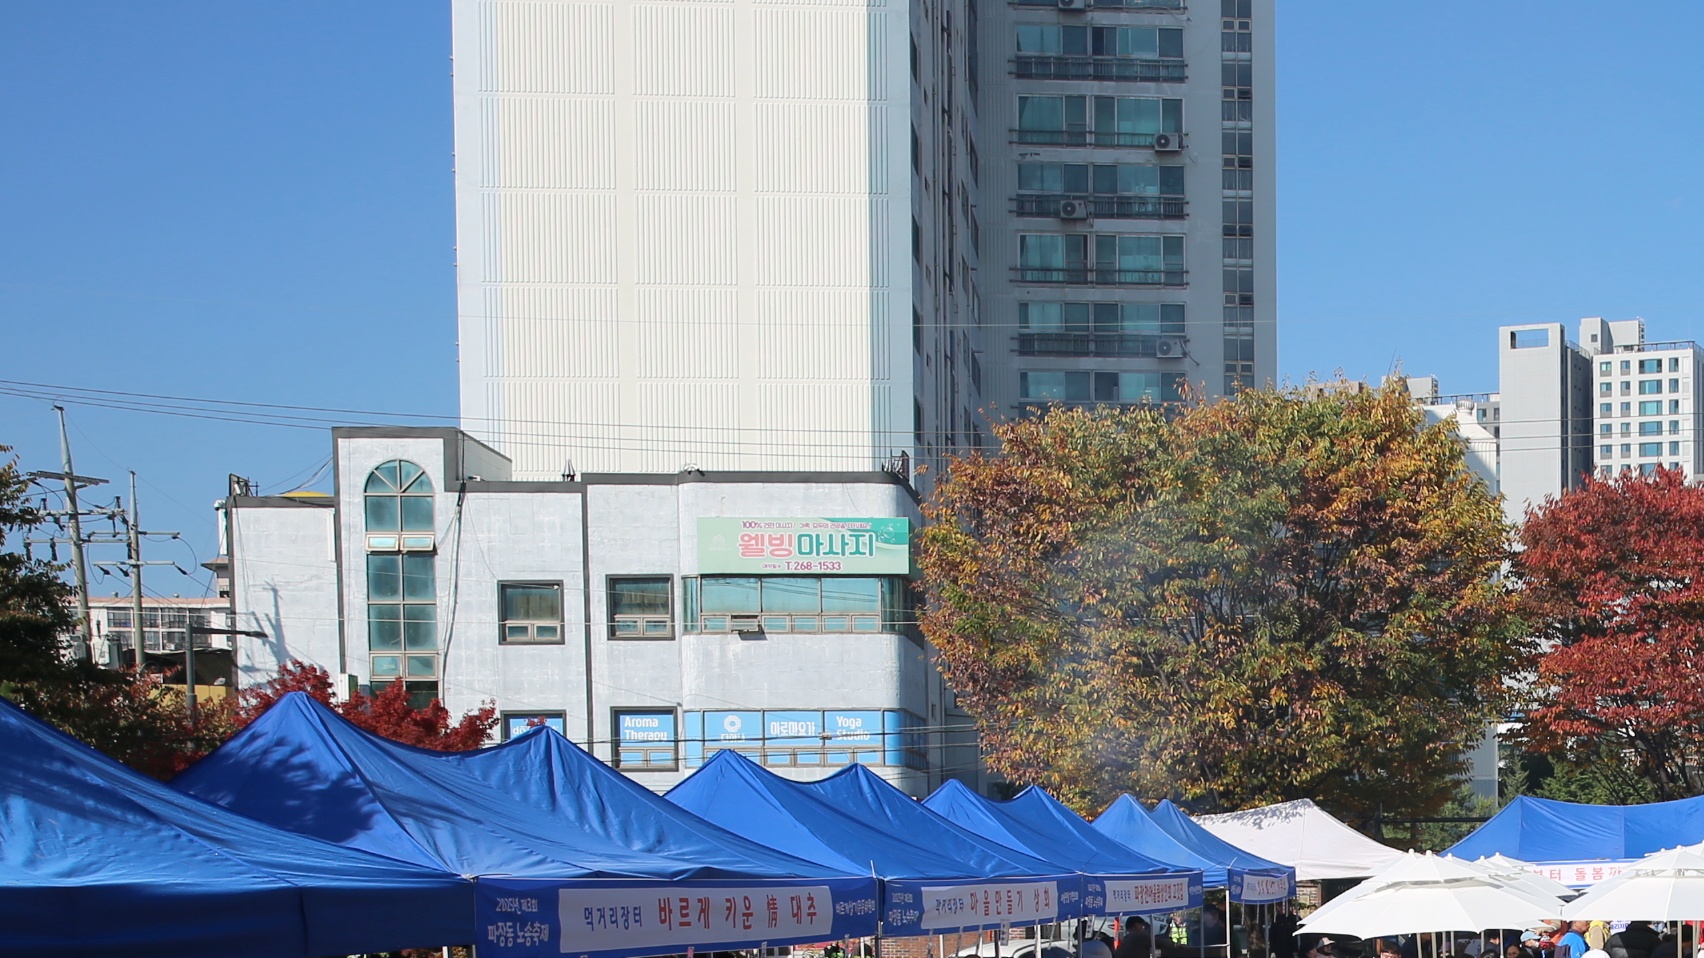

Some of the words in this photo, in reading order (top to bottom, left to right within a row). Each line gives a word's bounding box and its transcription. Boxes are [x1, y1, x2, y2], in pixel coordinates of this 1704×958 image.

[741, 521, 762, 529] 100%
[739, 533, 794, 558] 웰빙
[797, 533, 875, 557] 마사지
[785, 561, 841, 571] T.268-1533
[624, 716, 659, 728] Aroma
[836, 716, 862, 728] Yoga
[624, 729, 668, 742] Therapy
[770, 721, 816, 737] 아로마요가
[836, 729, 870, 741] Studio
[970, 889, 1024, 916] 마을만들기
[583, 904, 643, 932] 먹거리장터
[658, 896, 711, 931] 바르게
[725, 895, 754, 930] 키운
[766, 894, 779, 929] 情
[789, 892, 818, 925] 대추
[487, 921, 514, 947] 파장동
[516, 920, 549, 946] 노송축제
